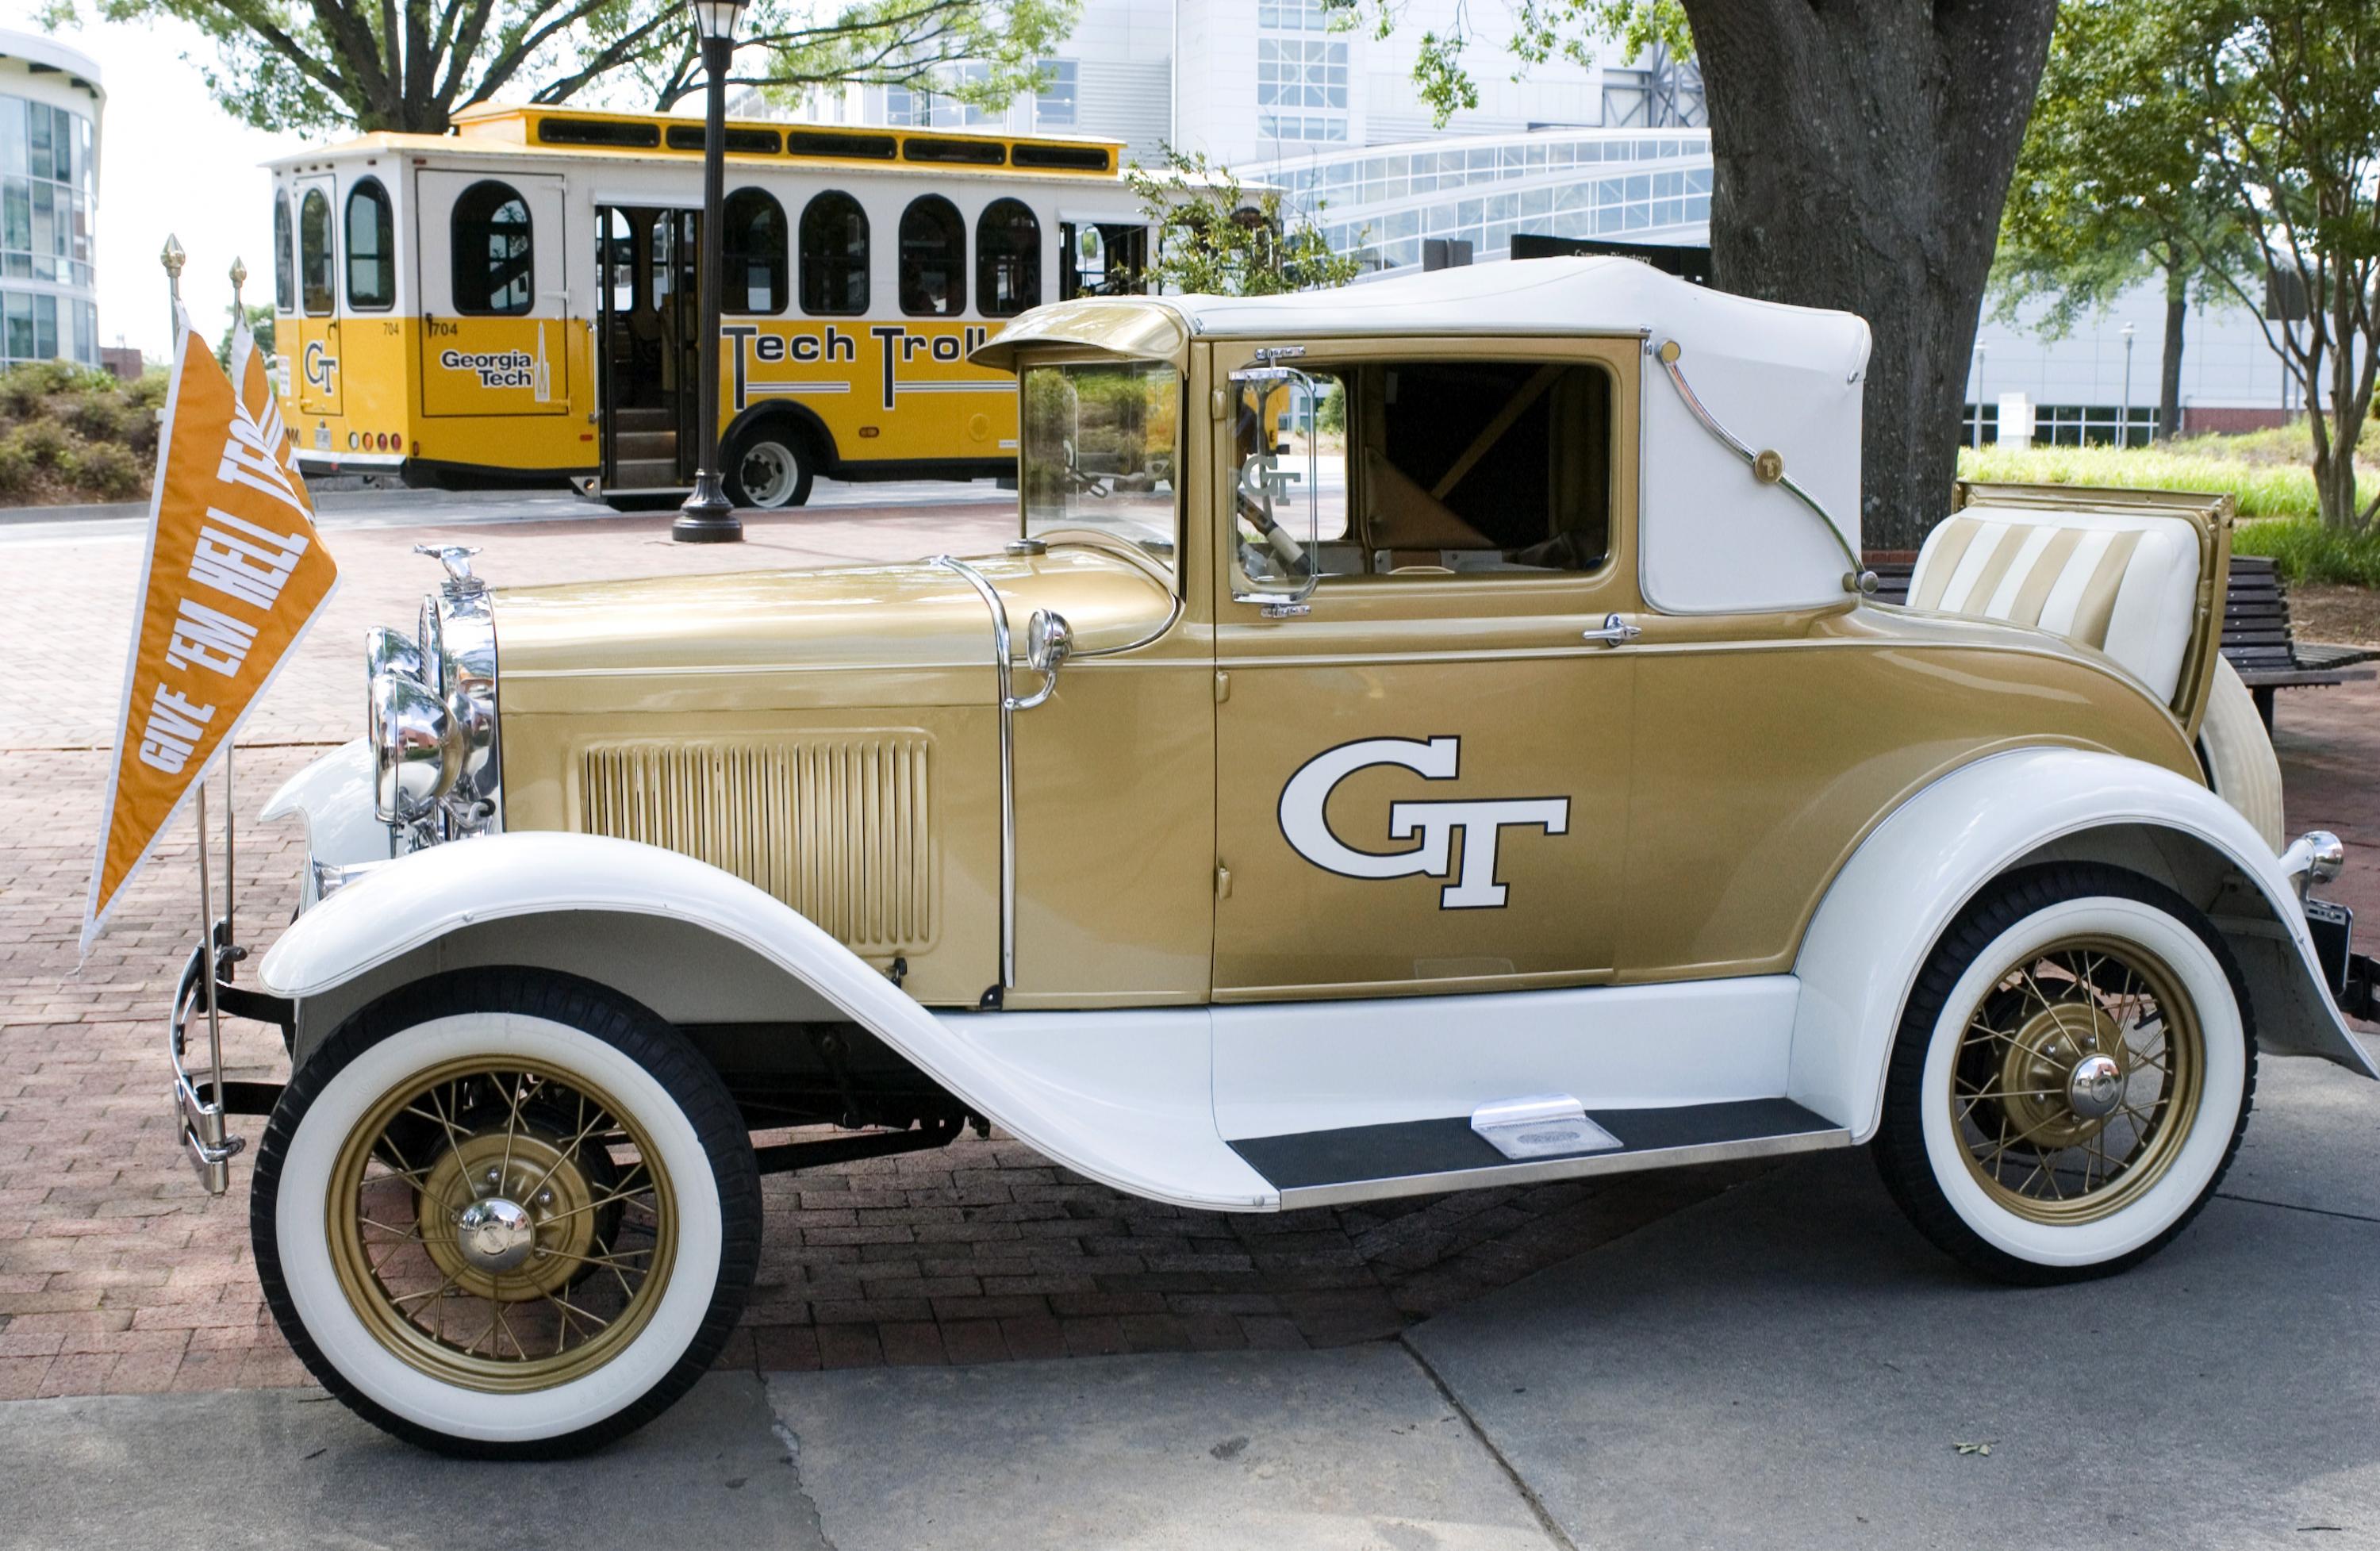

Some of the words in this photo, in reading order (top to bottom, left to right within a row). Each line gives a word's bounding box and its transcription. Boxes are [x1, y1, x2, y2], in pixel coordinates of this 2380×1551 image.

[382, 322, 399, 336] 704
[434, 323, 458, 336] 704
[305, 341, 337, 394] GT
[440, 350, 533, 371] Georgia
[478, 369, 533, 387] Tech
[721, 326, 855, 410] Tech
[1242, 455, 1300, 506] GT
[187, 506, 310, 611] HELL
[165, 597, 259, 679] 'EM
[139, 681, 217, 775] GIVE
[1276, 735, 1572, 910] GT
